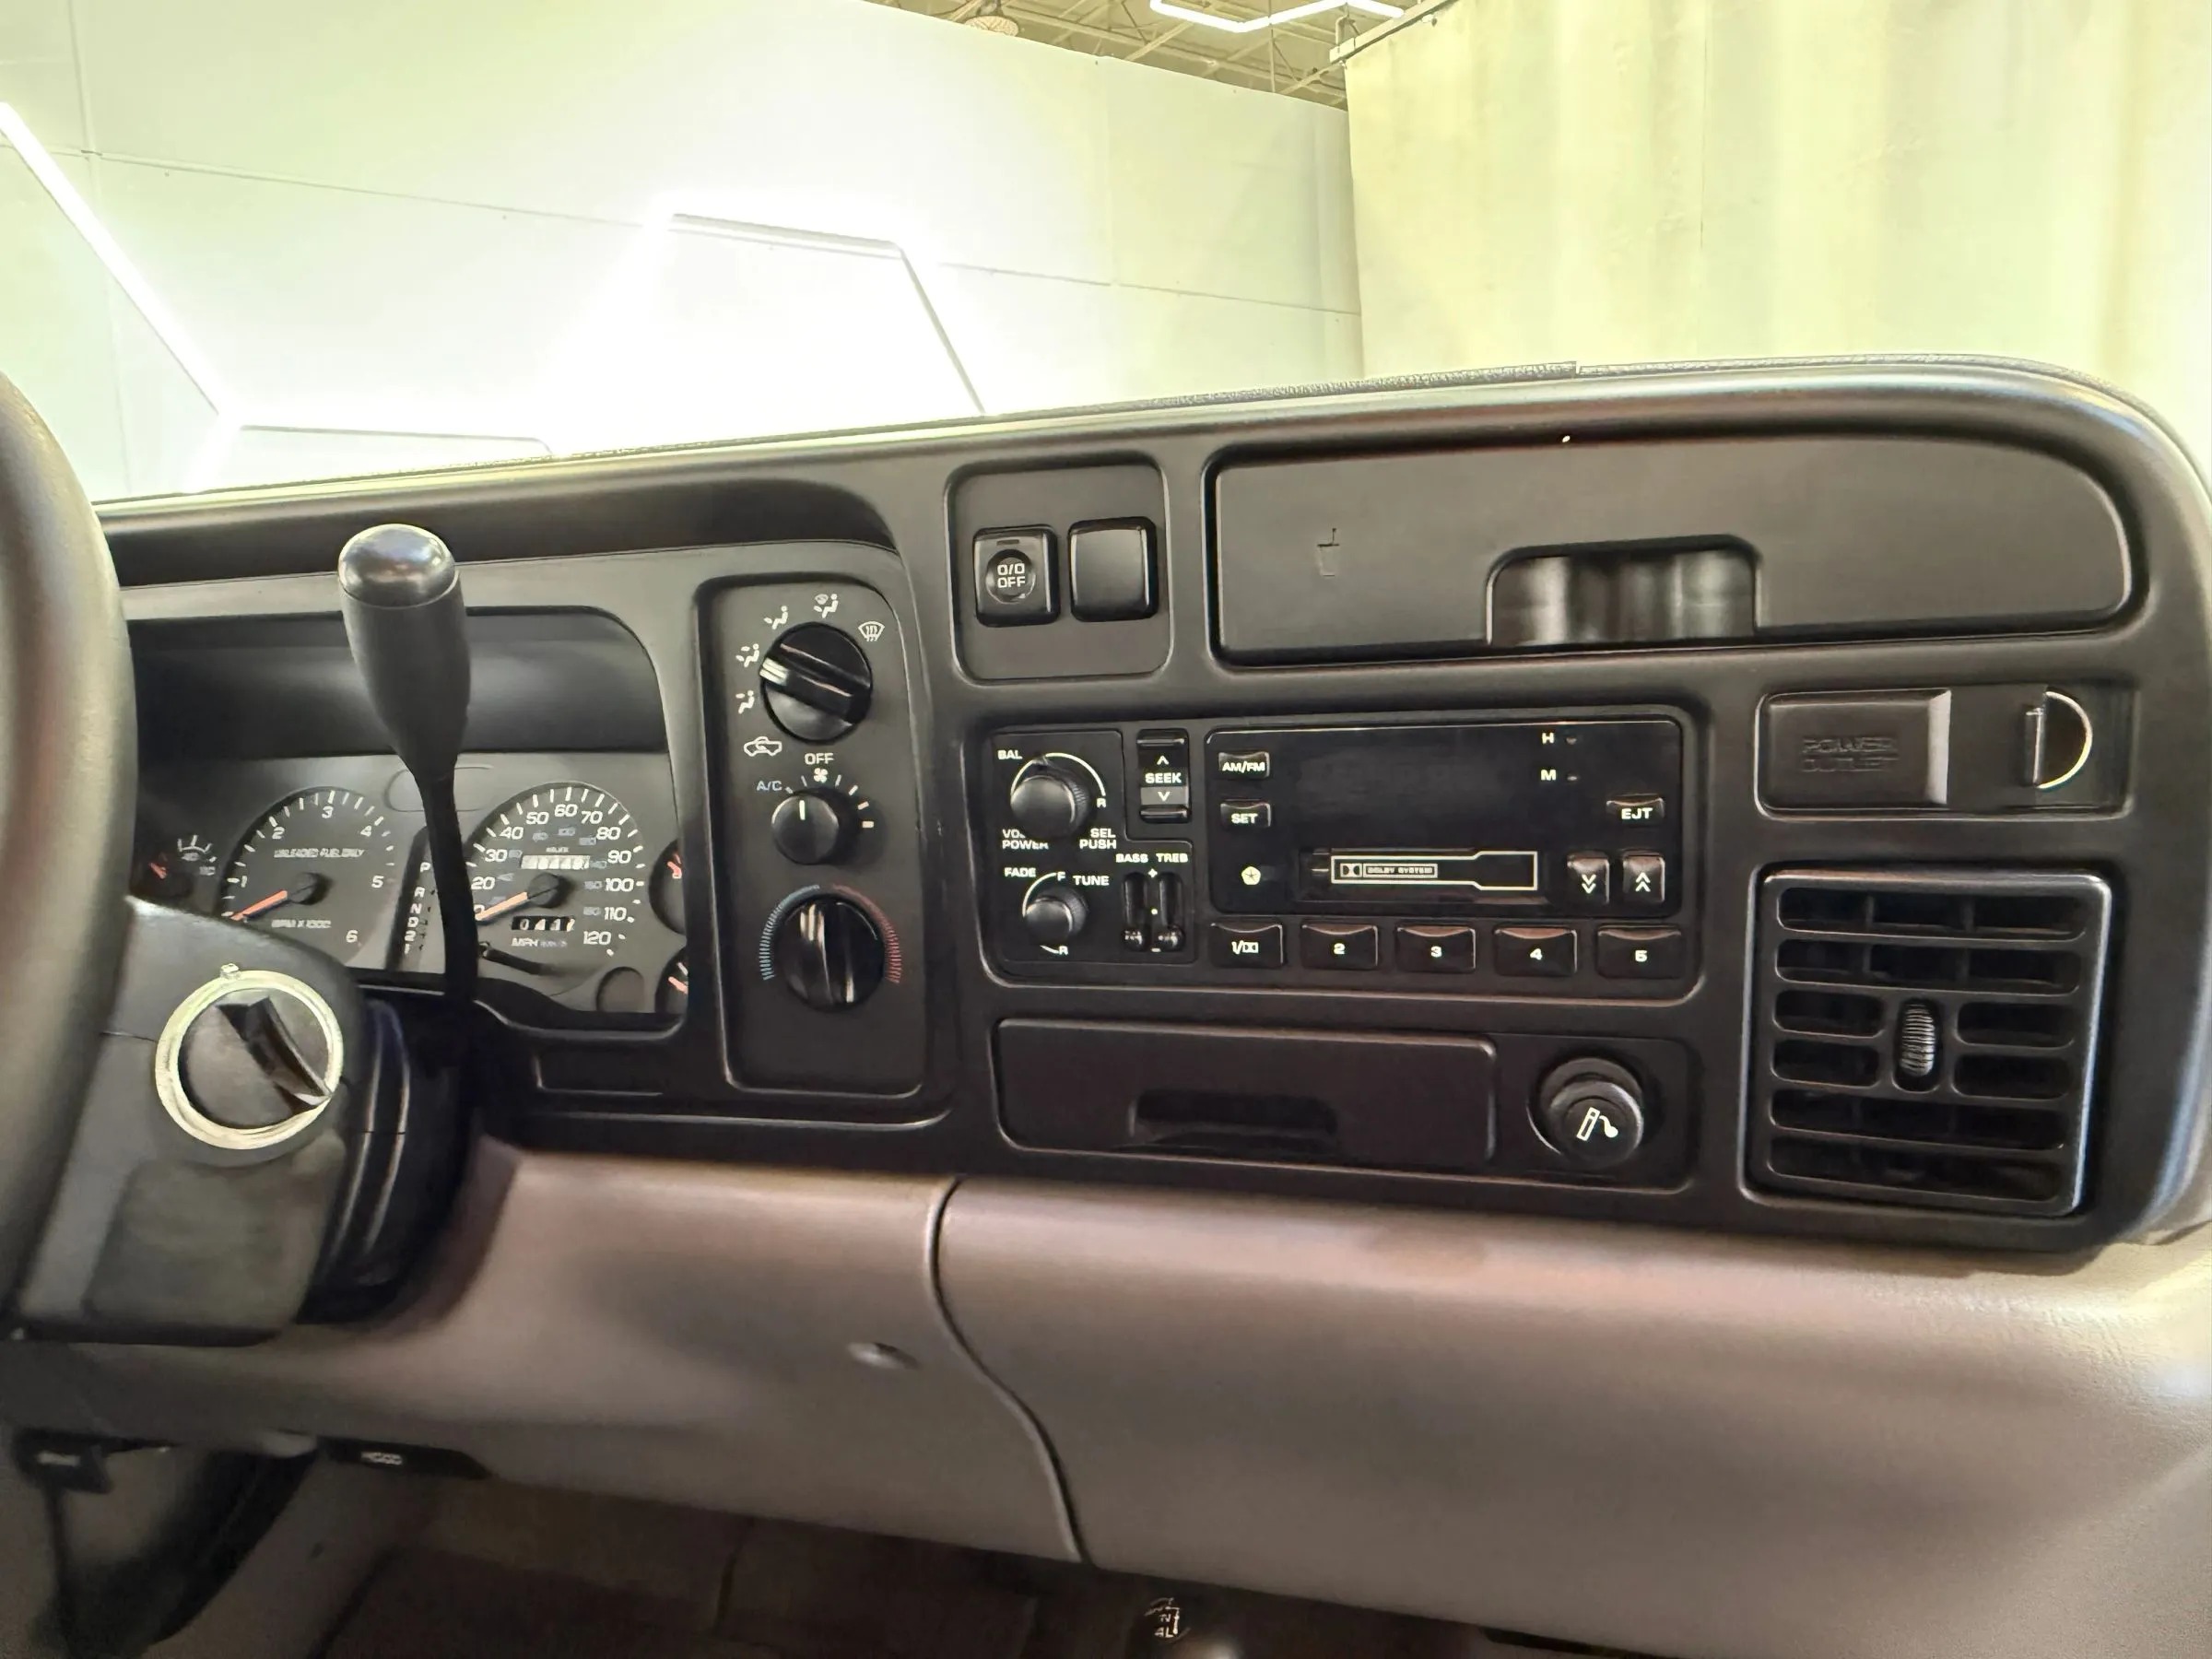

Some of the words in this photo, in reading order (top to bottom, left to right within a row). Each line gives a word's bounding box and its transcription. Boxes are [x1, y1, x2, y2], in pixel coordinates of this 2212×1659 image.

[996, 562, 1025, 576] O/D
[997, 576, 1026, 589] OFF
[1541, 732, 1555, 744] H
[804, 753, 834, 765] OFF
[997, 749, 1022, 760] BAL
[1221, 761, 1265, 773] AM/FM
[1145, 772, 1182, 783] SEEK
[1540, 769, 1557, 781] M
[756, 781, 782, 791] A/C
[1096, 798, 1106, 808] R
[322, 806, 334, 818] 3
[554, 804, 578, 818] 60
[581, 810, 604, 824] 70
[1621, 807, 1653, 819] EJT
[525, 811, 549, 825] 50
[1230, 813, 1258, 824] SET
[271, 827, 285, 840] 2
[360, 825, 372, 837] 4
[500, 827, 524, 840] 40
[595, 827, 621, 841] 80
[1090, 828, 1116, 839] SEL
[1079, 839, 1117, 850] PUSH
[484, 849, 508, 863] 30
[607, 850, 632, 864] 90
[1115, 853, 1148, 863] BASS
[1156, 853, 1189, 863] TREB
[419, 862, 431, 873] P
[1004, 867, 1037, 877] FADE
[241, 876, 248, 888] 1
[371, 876, 384, 888] 5
[1057, 871, 1066, 882] F
[1073, 876, 1110, 886] TUNE
[471, 877, 496, 890] 20
[605, 877, 634, 892] 100
[410, 903, 422, 914] N
[604, 906, 628, 922] 110
[346, 930, 359, 943] 6
[405, 930, 416, 942] 2
[582, 931, 612, 946] 120
[1058, 946, 1068, 956] R
[1333, 943, 1346, 955] 2
[1430, 946, 1442, 958] 3
[1529, 947, 1543, 960] 4
[1634, 949, 1648, 962] 5
